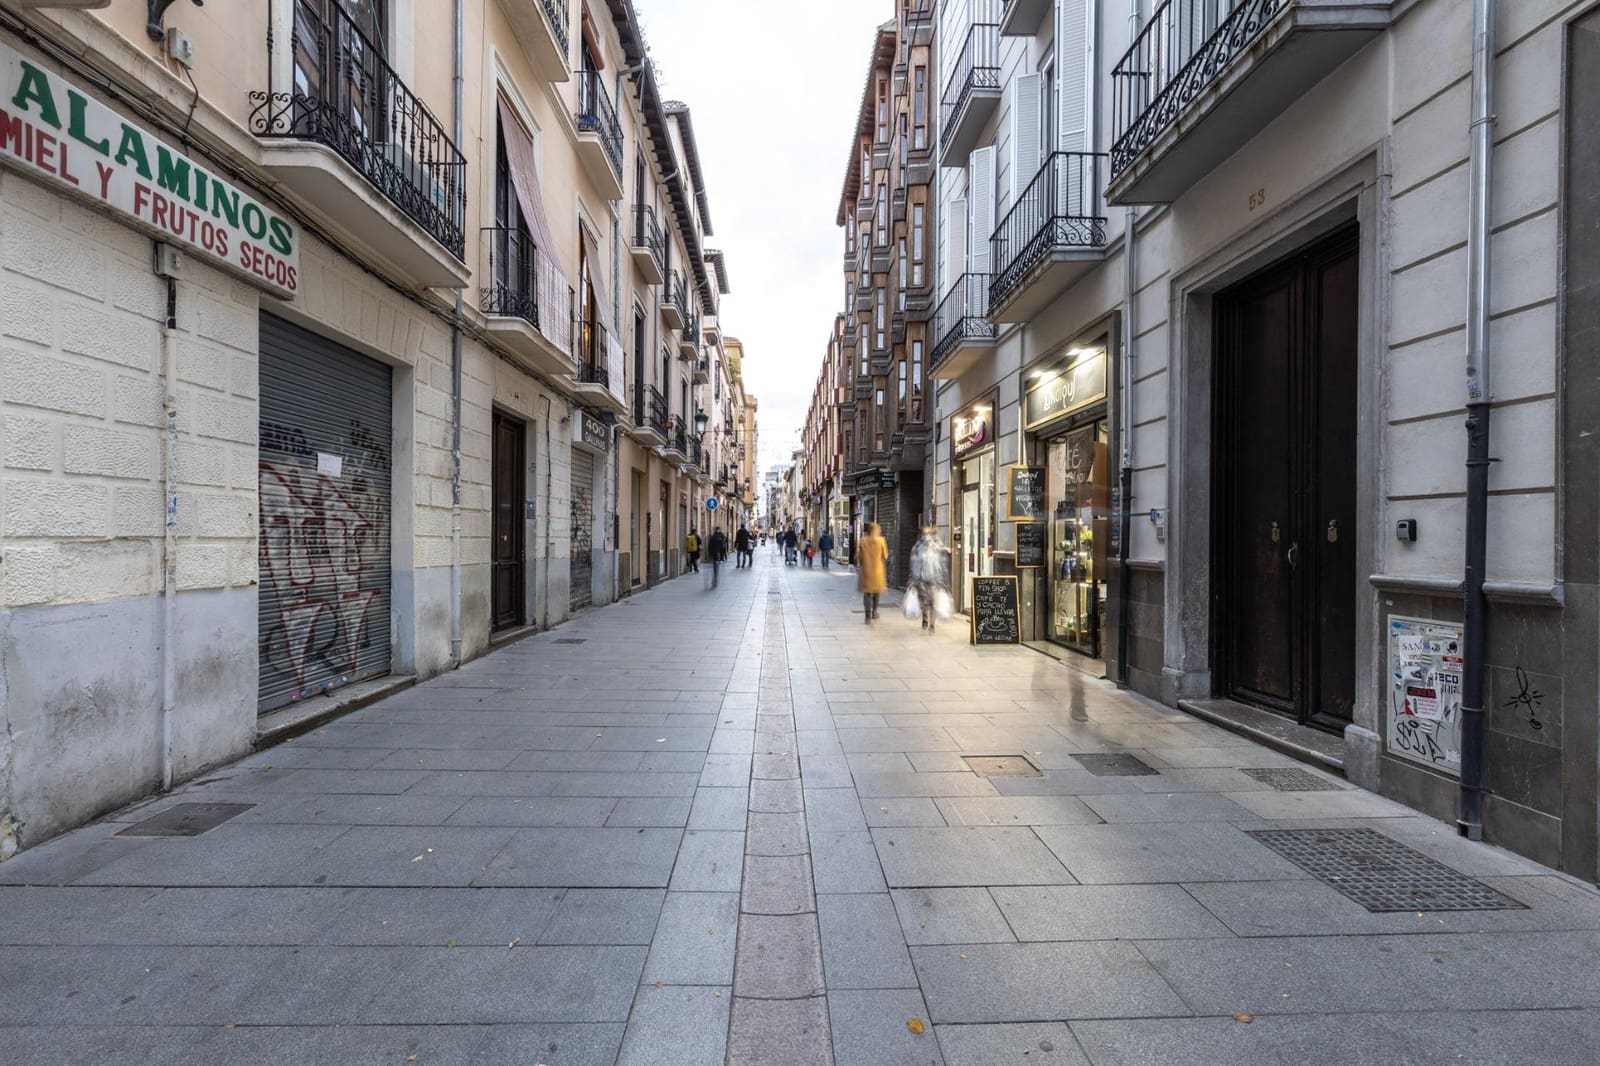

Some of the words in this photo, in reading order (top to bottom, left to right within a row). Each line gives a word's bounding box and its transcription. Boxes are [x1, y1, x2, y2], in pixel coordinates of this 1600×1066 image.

[0, 108, 80, 186] MIEL
[96, 160, 114, 200] Y
[134, 182, 229, 258] FRUTOS
[240, 240, 298, 292] SECOS
[12, 60, 294, 256] ALAMINOS
[586, 419, 605, 437] 400
